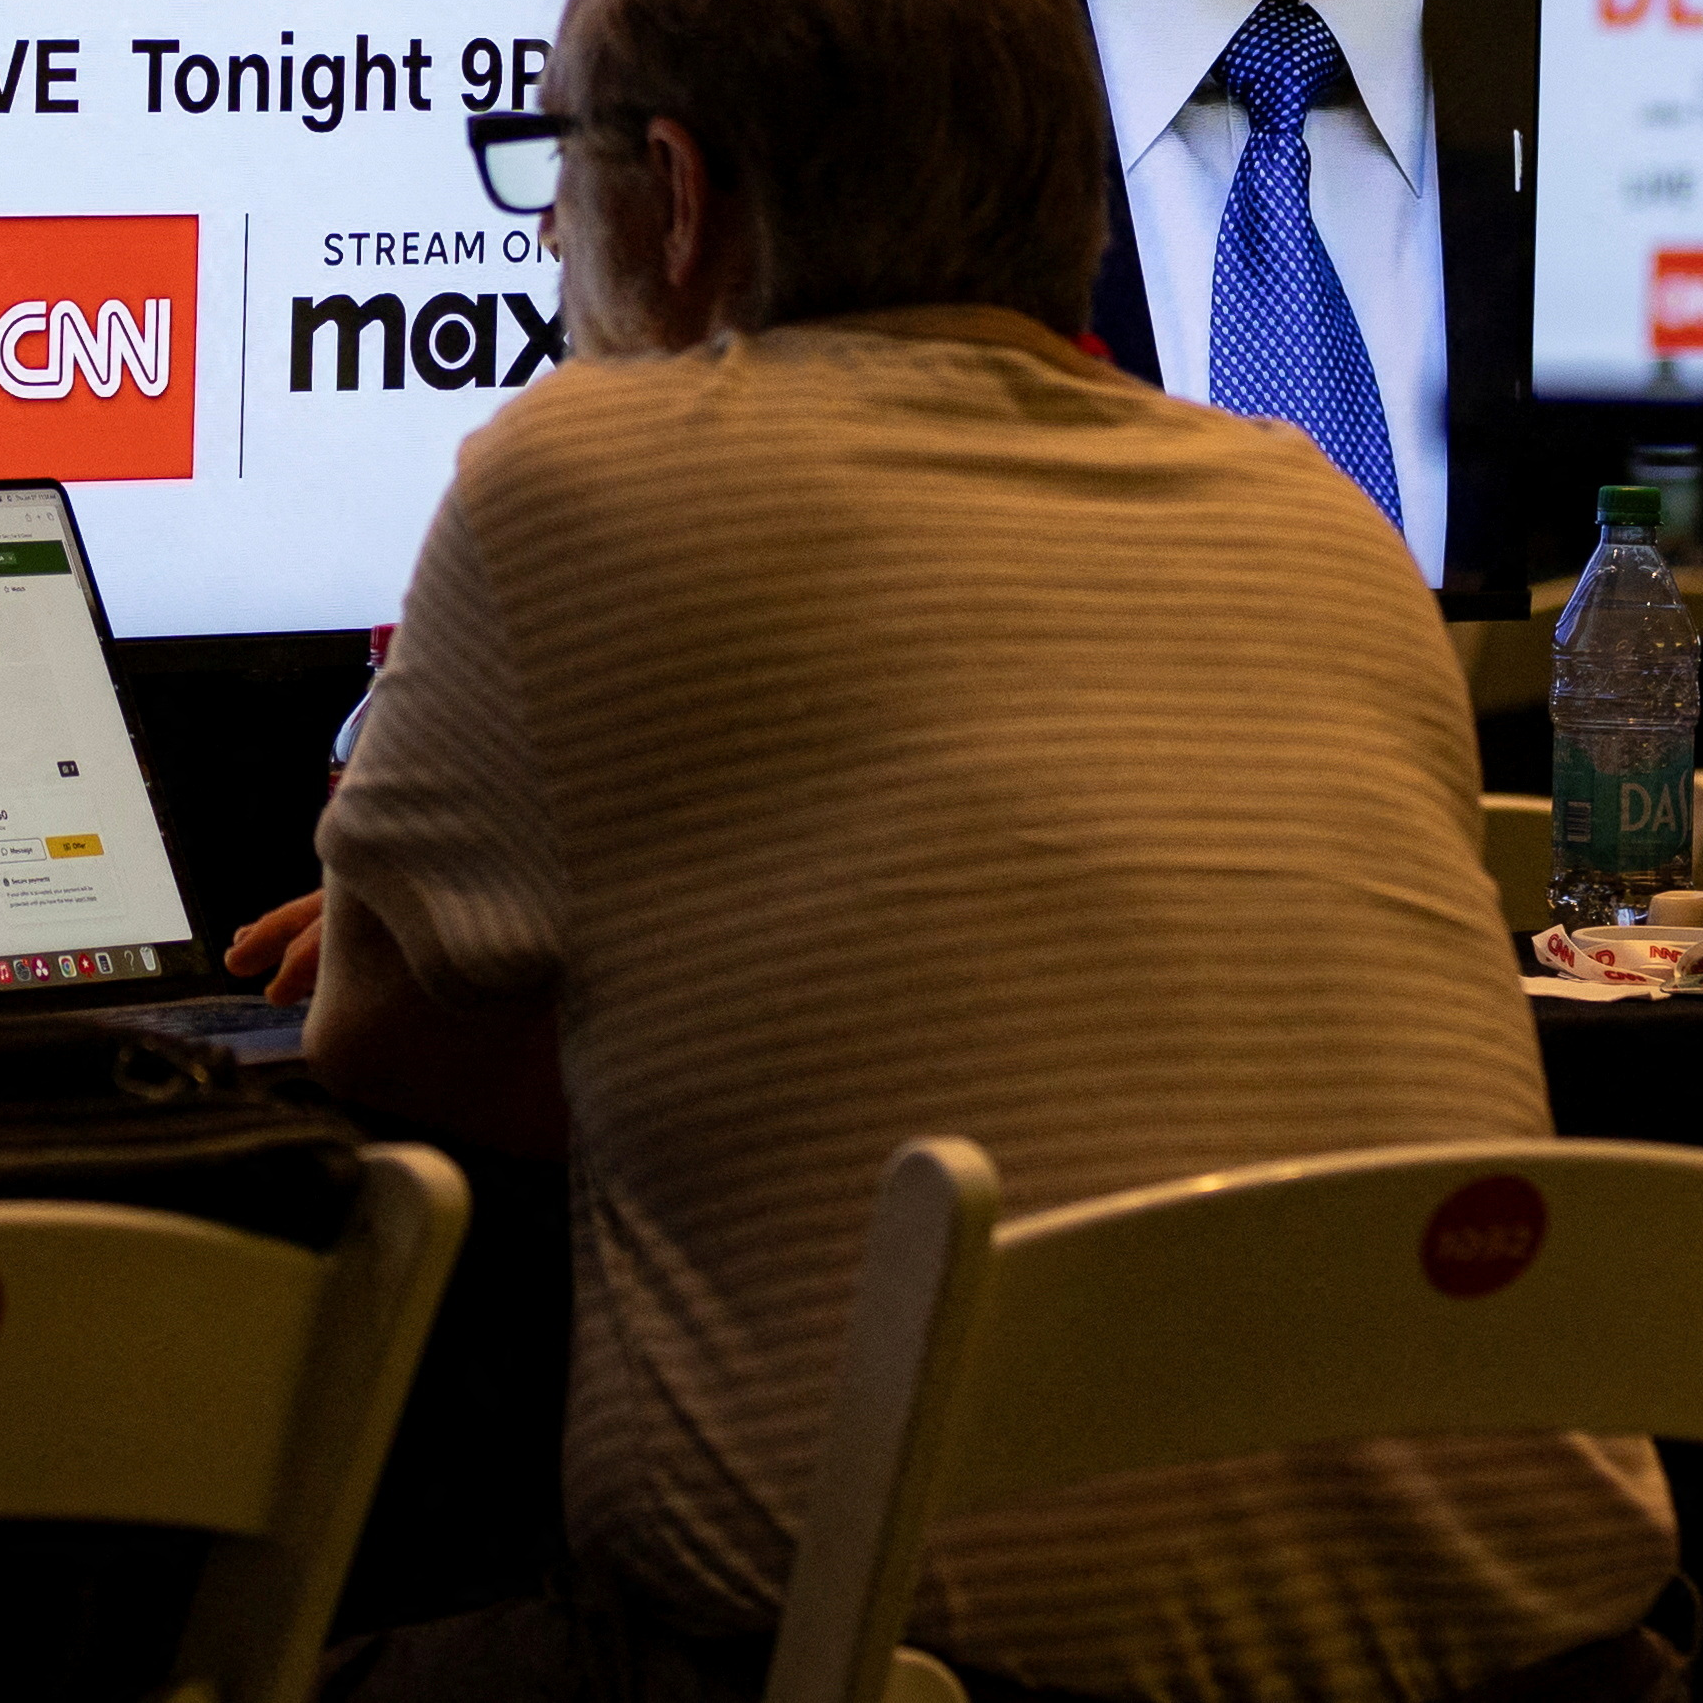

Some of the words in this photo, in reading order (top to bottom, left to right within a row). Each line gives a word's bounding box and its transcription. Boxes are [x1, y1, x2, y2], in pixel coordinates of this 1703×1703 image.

[131, 30, 433, 133] Tonight
[461, 37, 554, 113] 9P
[323, 231, 485, 266] STREAM
[289, 292, 573, 394] max
